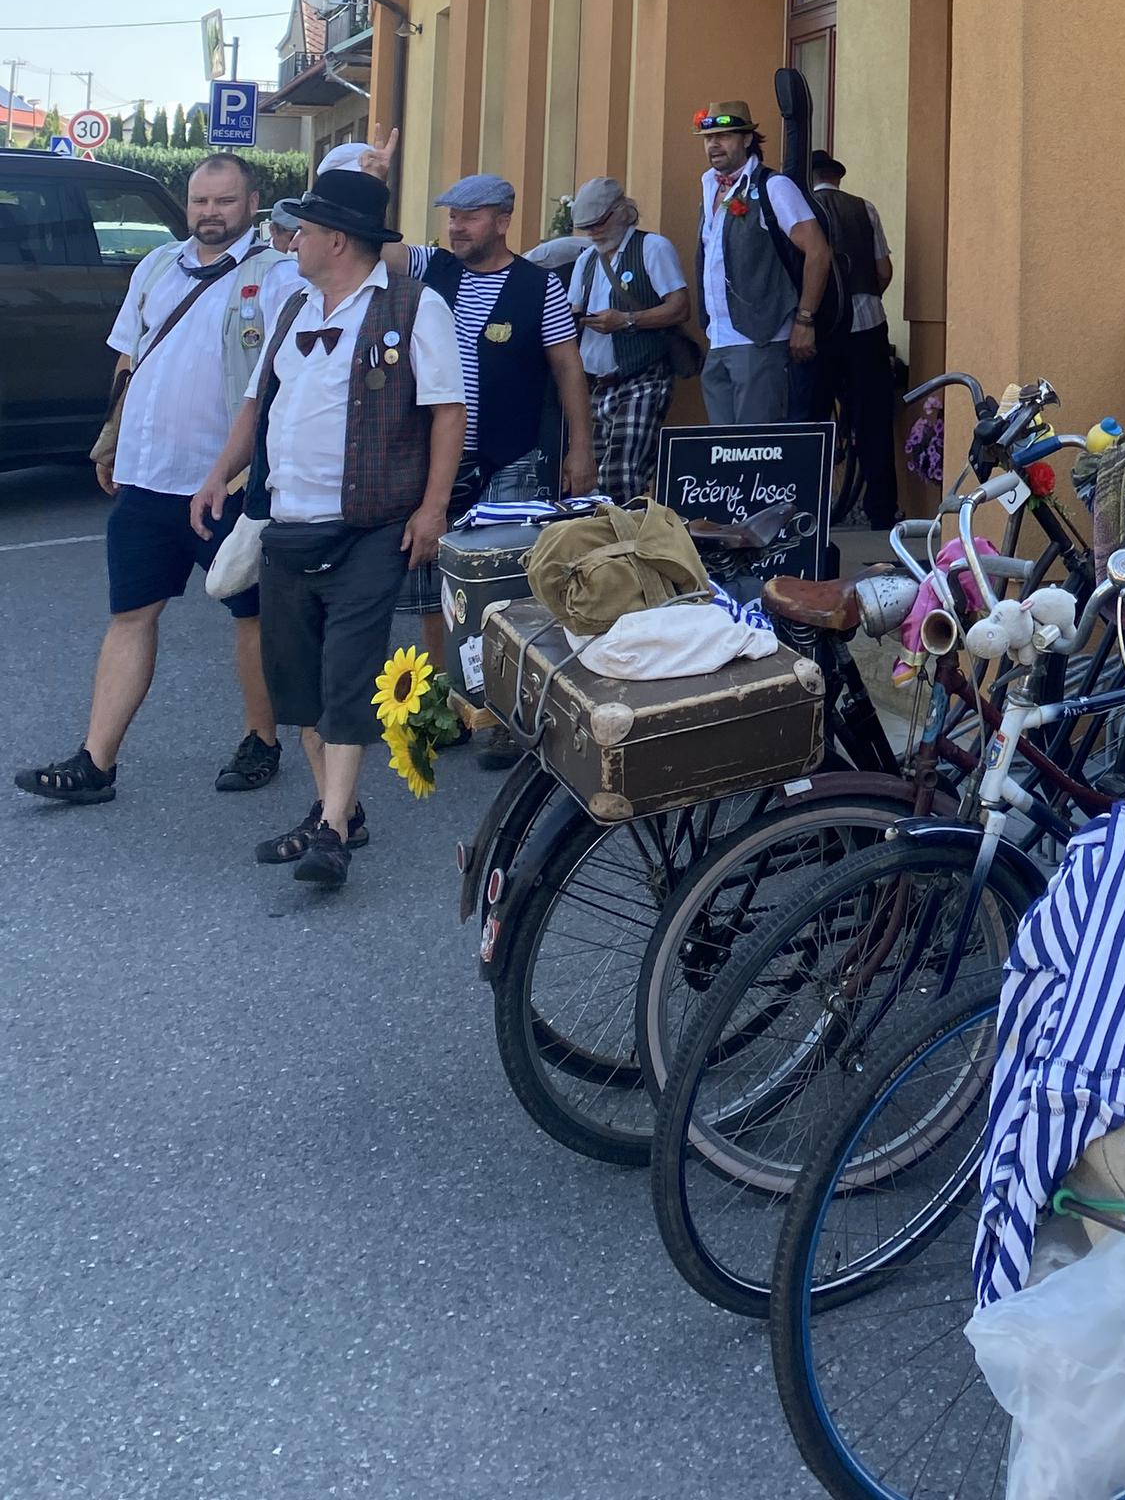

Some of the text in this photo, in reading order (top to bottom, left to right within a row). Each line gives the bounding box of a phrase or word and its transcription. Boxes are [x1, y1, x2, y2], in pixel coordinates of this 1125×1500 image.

[220, 89, 247, 125] P
[76, 120, 101, 139] 30
[711, 446, 783, 464] PRIMATOR
[677, 472, 797, 513] Pečený losos
